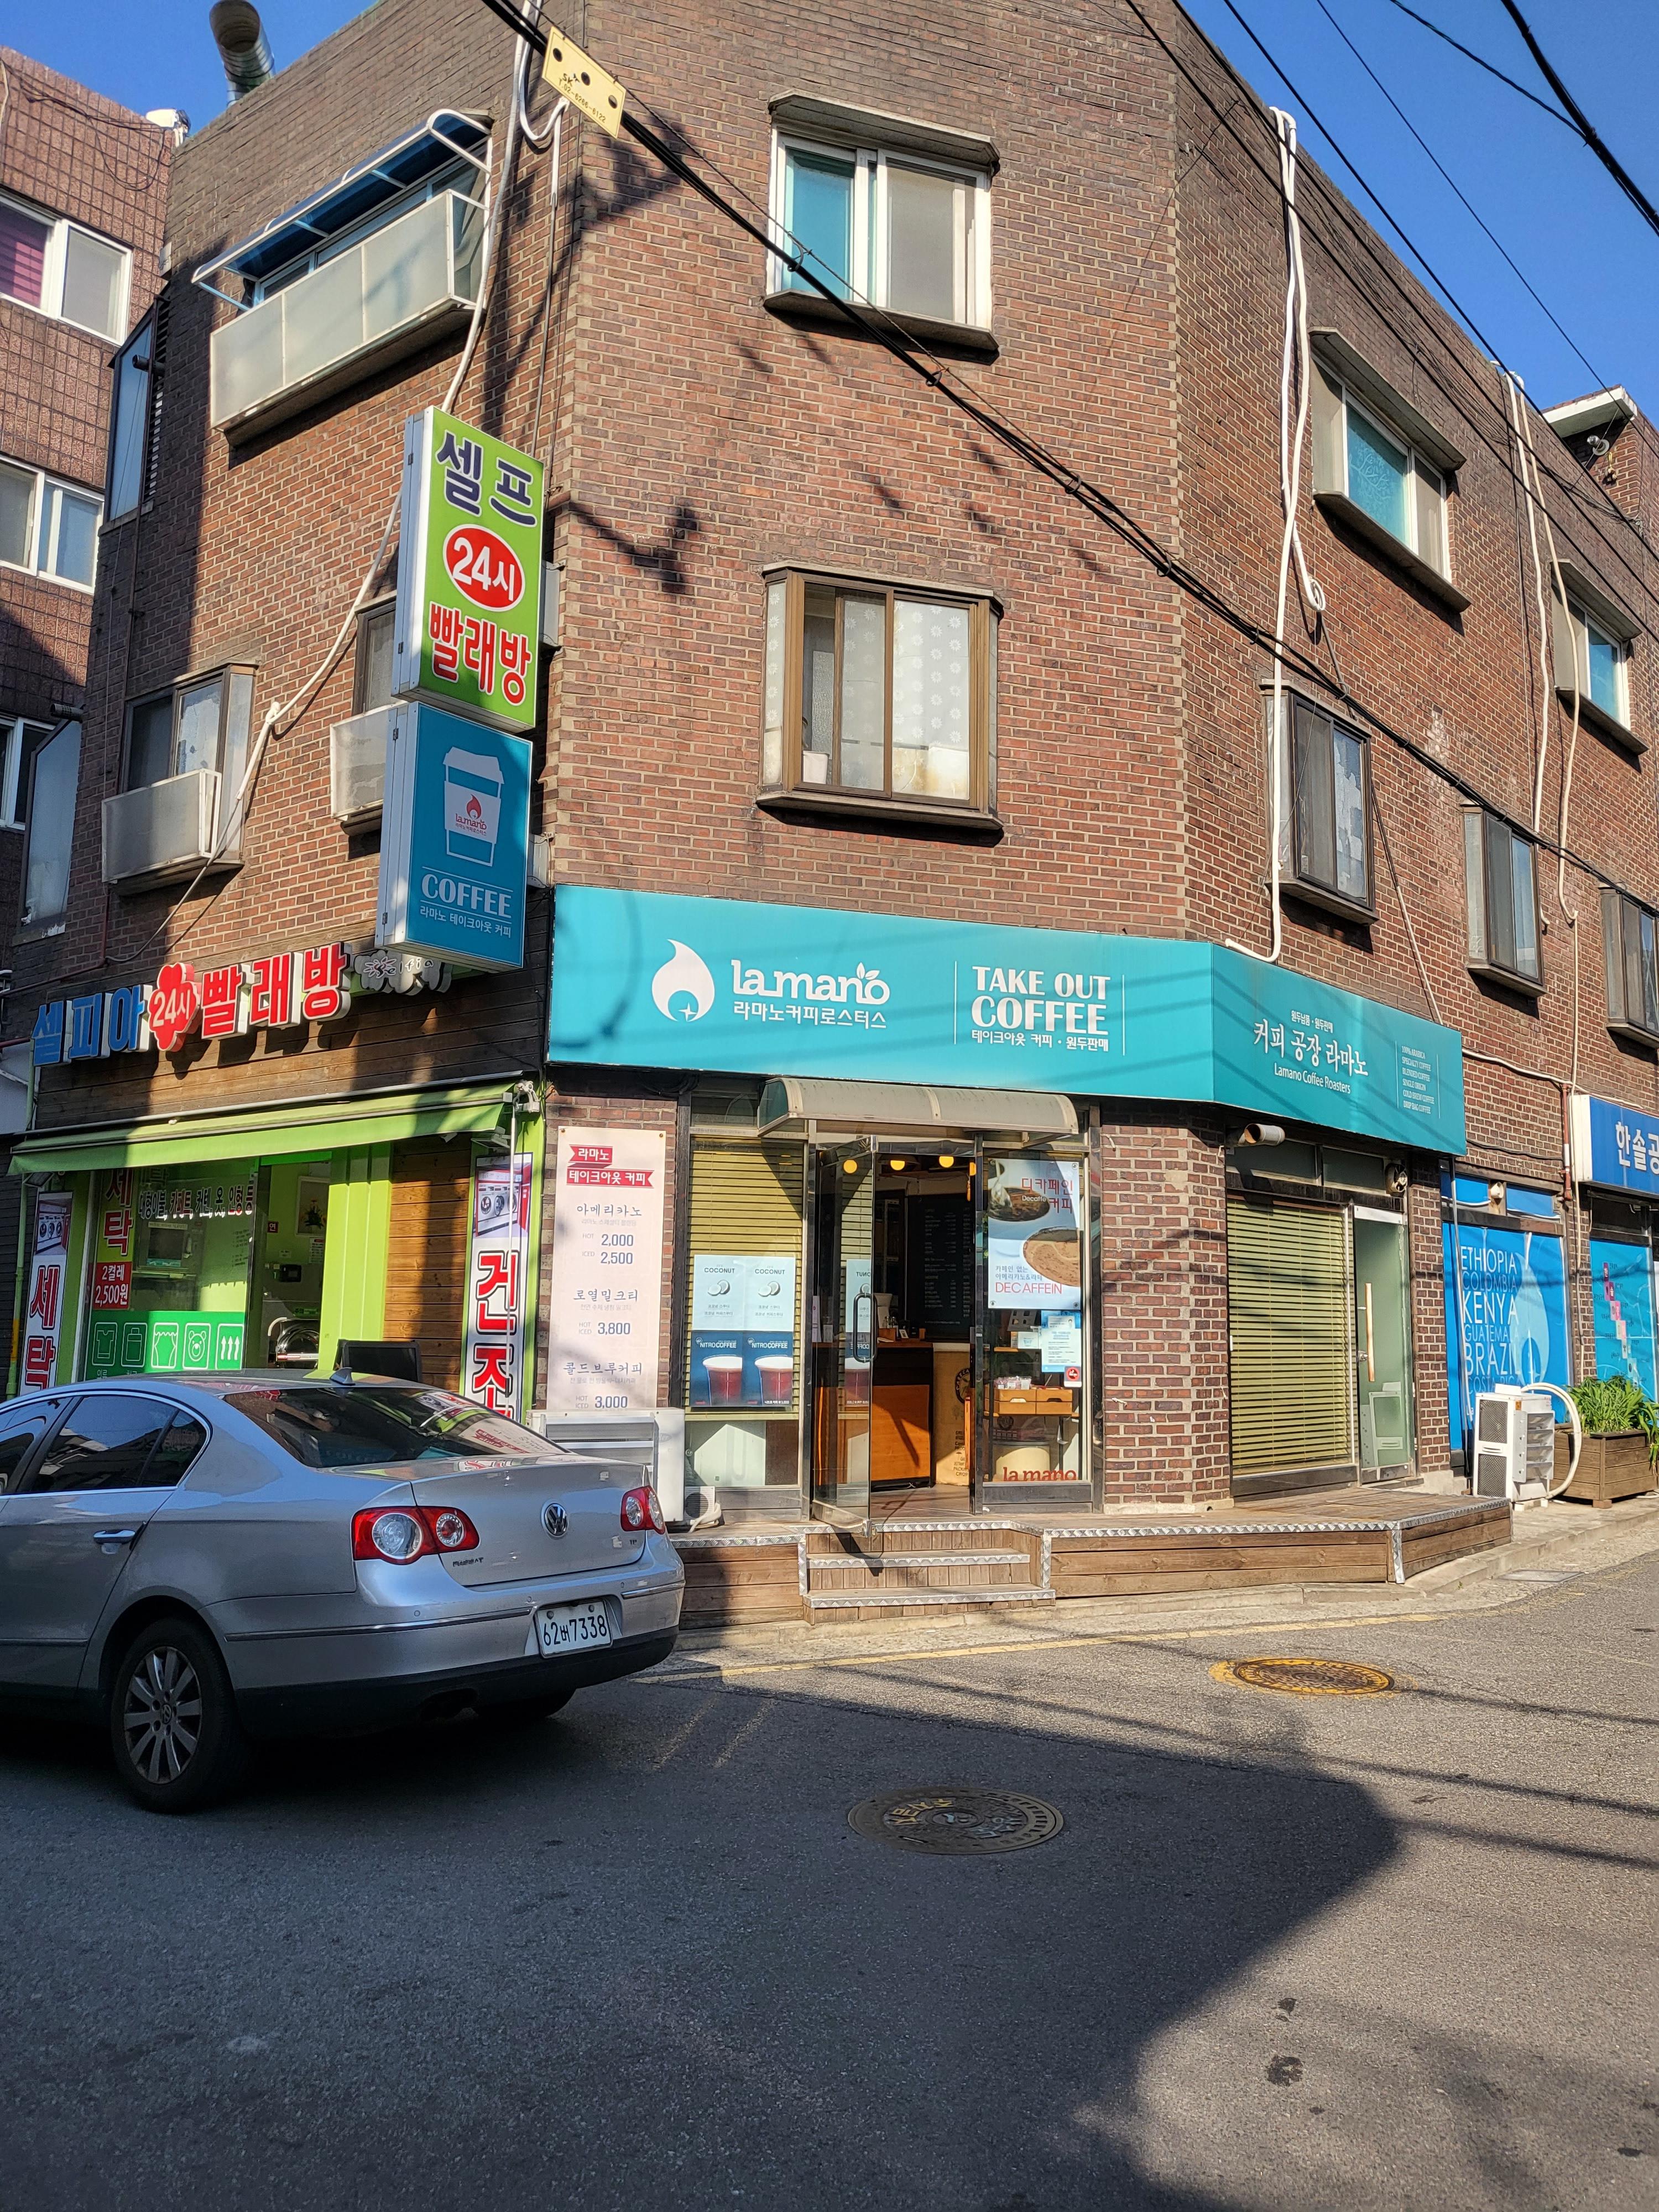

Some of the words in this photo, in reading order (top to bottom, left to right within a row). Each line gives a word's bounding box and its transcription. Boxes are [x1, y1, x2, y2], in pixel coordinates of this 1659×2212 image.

[436, 430, 537, 526] 셀프
[452, 536, 515, 602] 24시
[429, 601, 532, 706] 빨래방
[422, 874, 512, 919] COFFEE
[420, 905, 447, 922] 라마노
[450, 912, 492, 933] 테이크아웃
[494, 924, 511, 938] 커피
[972, 966, 1045, 995] TAKE
[1054, 973, 1111, 1000] OUT
[32, 984, 145, 1067] 셀피아
[152, 991, 192, 1027] 24시
[201, 941, 348, 1040] 빨래방
[734, 1001, 886, 1029] 라마노커피로스터스
[972, 995, 1108, 1035] COFFEE
[1291, 1010, 1311, 1026] 원두납품
[1314, 1017, 1333, 1034] 원두판매
[972, 1029, 1026, 1047] 테이크아웃
[1031, 1033, 1053, 1048] 커피
[1066, 1036, 1109, 1052] 원두판매
[1254, 1018, 1285, 1058] 커피
[1290, 1029, 1322, 1067] 공장
[1326, 1040, 1369, 1077] 라마노
[1274, 1062, 1302, 1081] Lamano
[1302, 1070, 1323, 1087] Coffee
[1324, 1076, 1350, 1094] Roasters
[1402, 1067, 1417, 1078] BLENDED
[1418, 1072, 1431, 1082] COFFEE
[1419, 1061, 1431, 1072] COFFEE
[1418, 1104, 1431, 1114] COFFEE
[1422, 1094, 1434, 1104] COFFEE
[578, 1148, 609, 1161] 라마노
[569, 1170, 621, 1185] 테이크아웃
[625, 1172, 646, 1186] 커피
[577, 1203, 642, 1217] 아메리카노
[1047, 1197, 1072, 1214] 커피
[601, 1234, 634, 1246] 2,000
[601, 1252, 633, 1264] 2,500
[1460, 1246, 1517, 1275] ETHIOPIA
[1462, 1270, 1517, 1293] COLOMBIA
[95, 1284, 129, 1307] 2,500원
[573, 1288, 638, 1302] 로열밀크티
[1462, 1291, 1519, 1326] KENYA
[27, 1265, 60, 1390] 세탁
[598, 1322, 630, 1335] 3,800
[564, 1362, 642, 1375] 콜드브루커피
[1465, 1342, 1521, 1376] BRAZIL
[595, 1396, 628, 1408] 3,000
[543, 1614, 607, 1646] 62버7338
